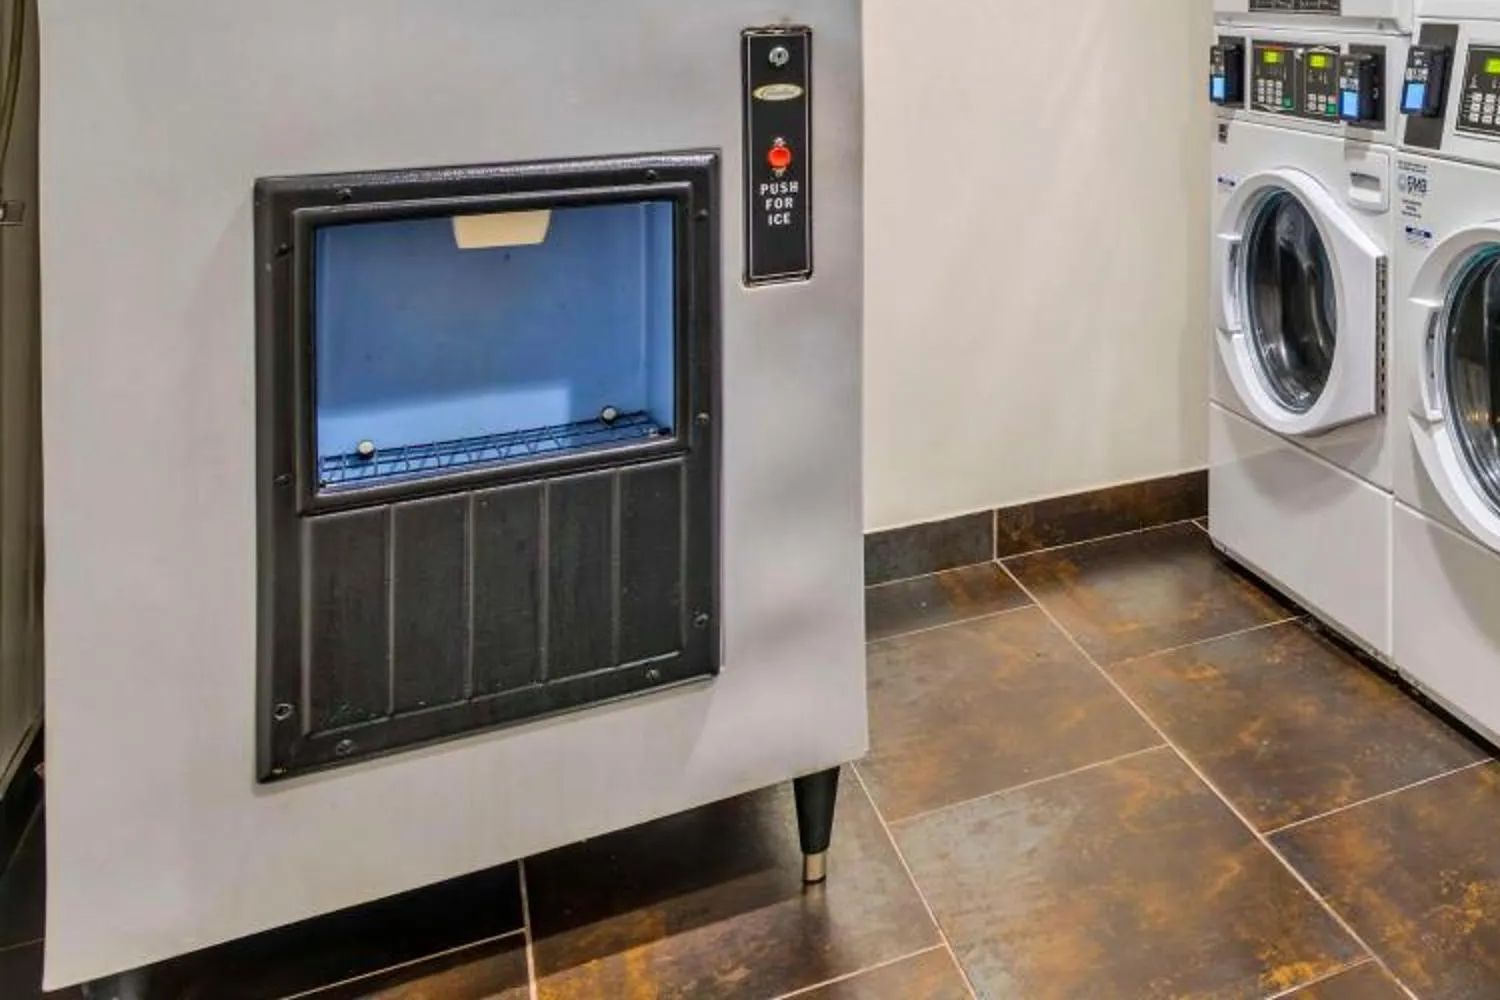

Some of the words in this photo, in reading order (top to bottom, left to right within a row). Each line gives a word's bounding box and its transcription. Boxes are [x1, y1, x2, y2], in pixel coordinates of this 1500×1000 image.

[760, 181, 799, 196] PUSH
[765, 198, 793, 211] FOR
[768, 212, 791, 227] ICE
